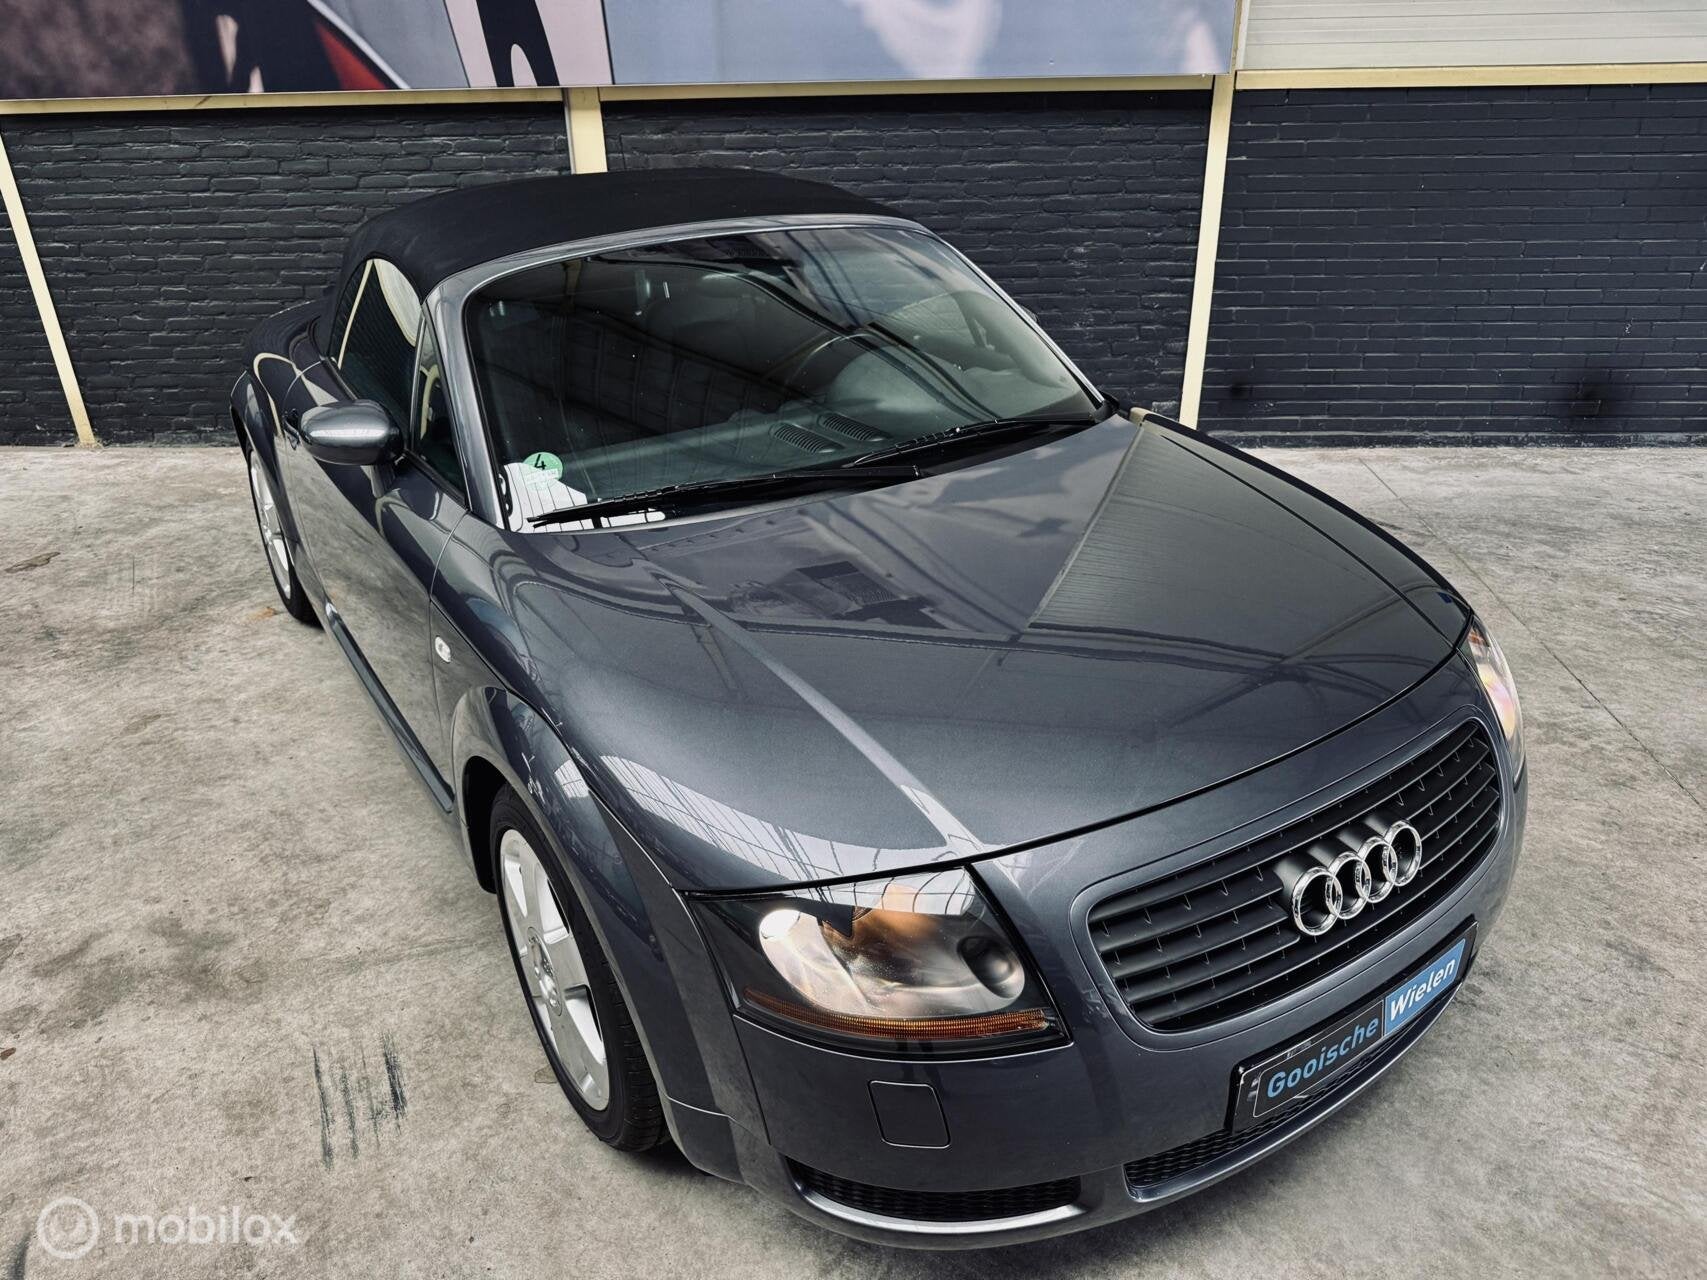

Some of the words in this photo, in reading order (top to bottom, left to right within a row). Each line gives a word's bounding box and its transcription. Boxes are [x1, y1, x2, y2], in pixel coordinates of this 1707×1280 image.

[534, 453, 547, 471] 4
[1267, 1017, 1379, 1098] Gooische
[1390, 957, 1456, 1022] Wielen
